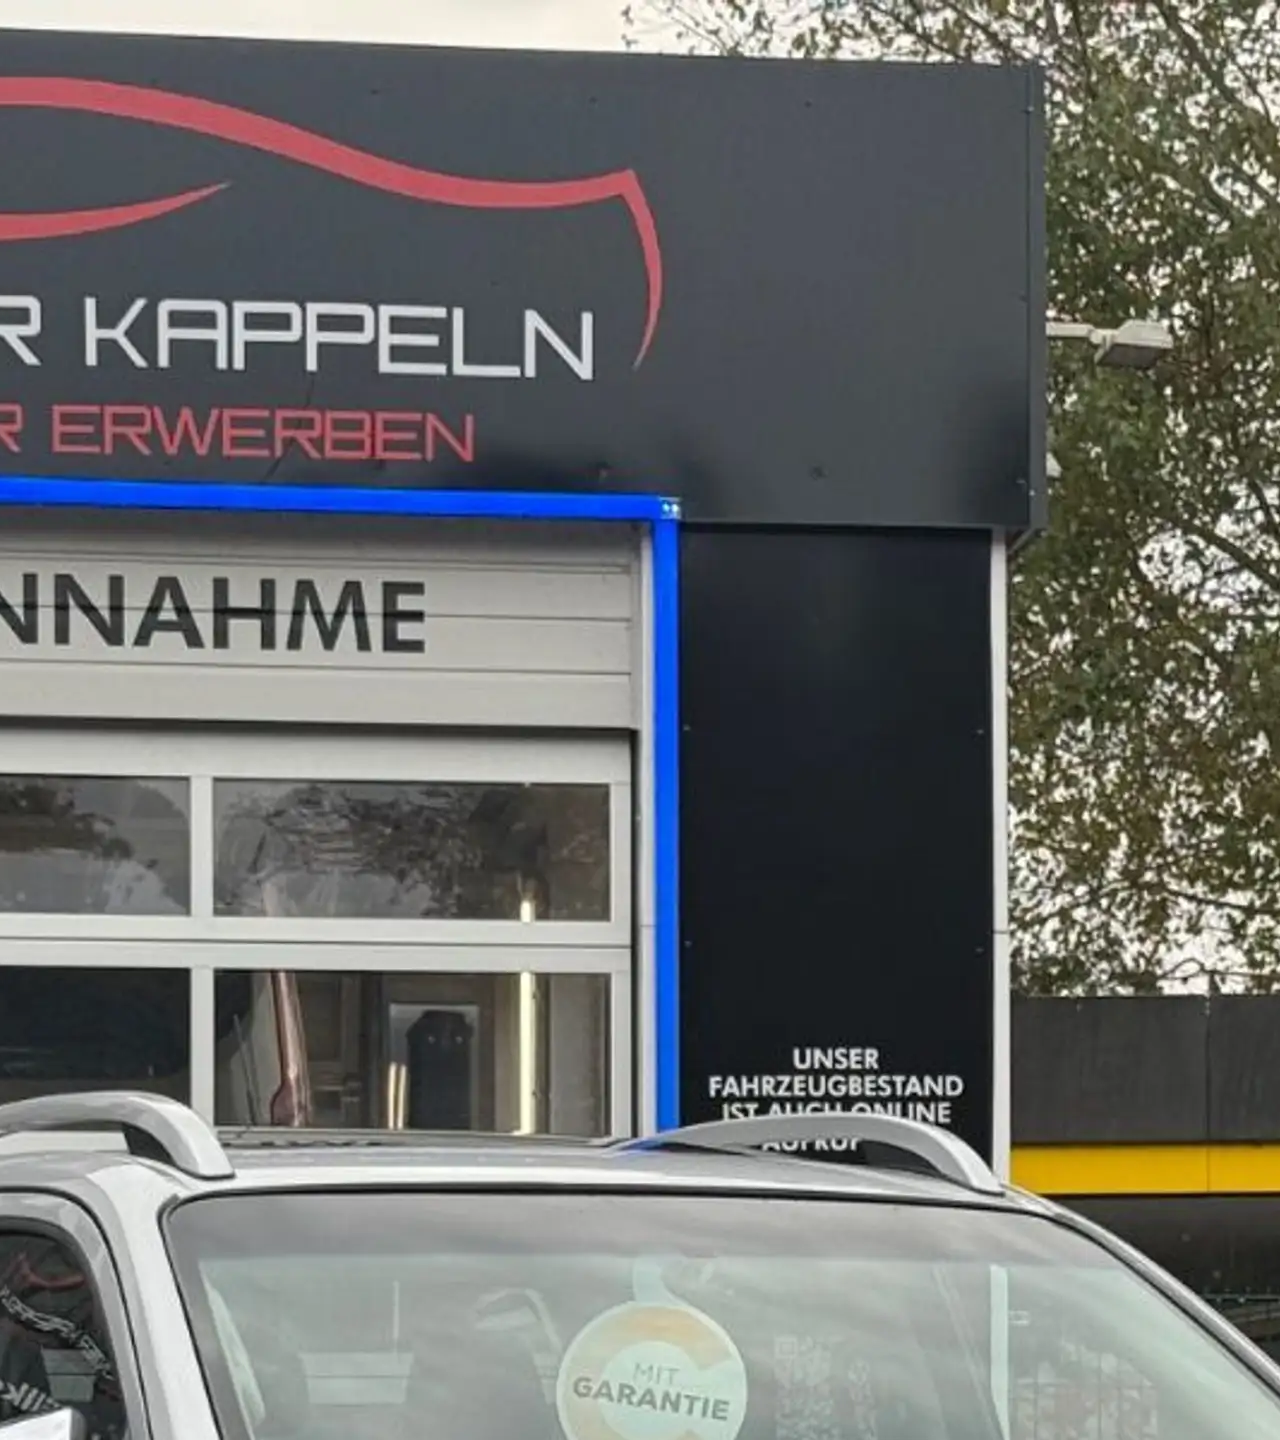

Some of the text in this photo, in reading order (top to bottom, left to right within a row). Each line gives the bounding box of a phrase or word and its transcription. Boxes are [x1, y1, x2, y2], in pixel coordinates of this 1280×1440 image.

[84, 296, 592, 380] KAPPELN
[52, 404, 474, 462] ERWERBEN
[793, 1048, 879, 1069] UNSER
[709, 1075, 964, 1098] FAHRZEUGBESTAND
[722, 1103, 758, 1120] IST
[851, 1103, 951, 1123] ONLINE
[632, 1362, 680, 1384] MIT
[573, 1377, 729, 1422] GARANTIE
